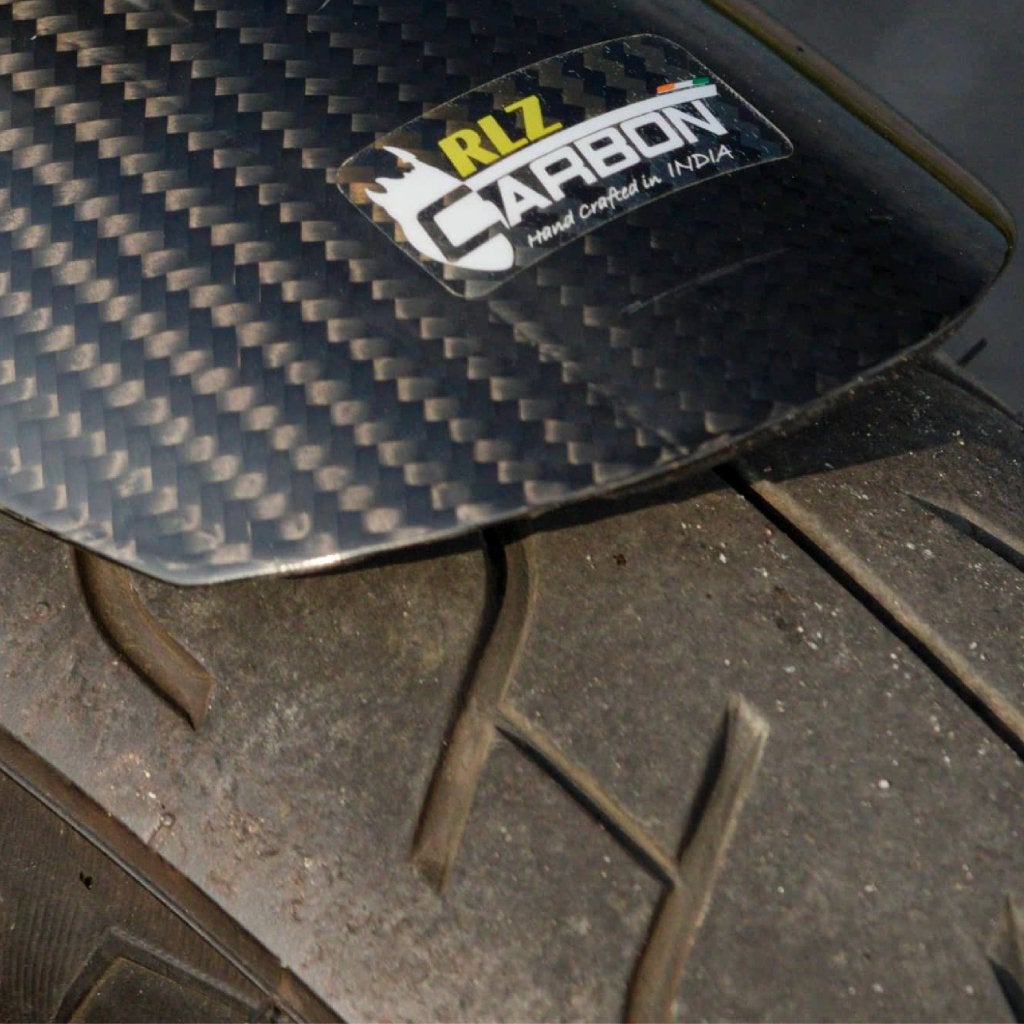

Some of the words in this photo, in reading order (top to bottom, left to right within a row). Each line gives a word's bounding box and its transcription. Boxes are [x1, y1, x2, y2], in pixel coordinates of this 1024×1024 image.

[414, 99, 729, 263] CARBON
[438, 95, 563, 177] RLZ
[527, 210, 576, 248] Hand
[642, 174, 663, 190] in
[667, 144, 734, 178] INDIA
